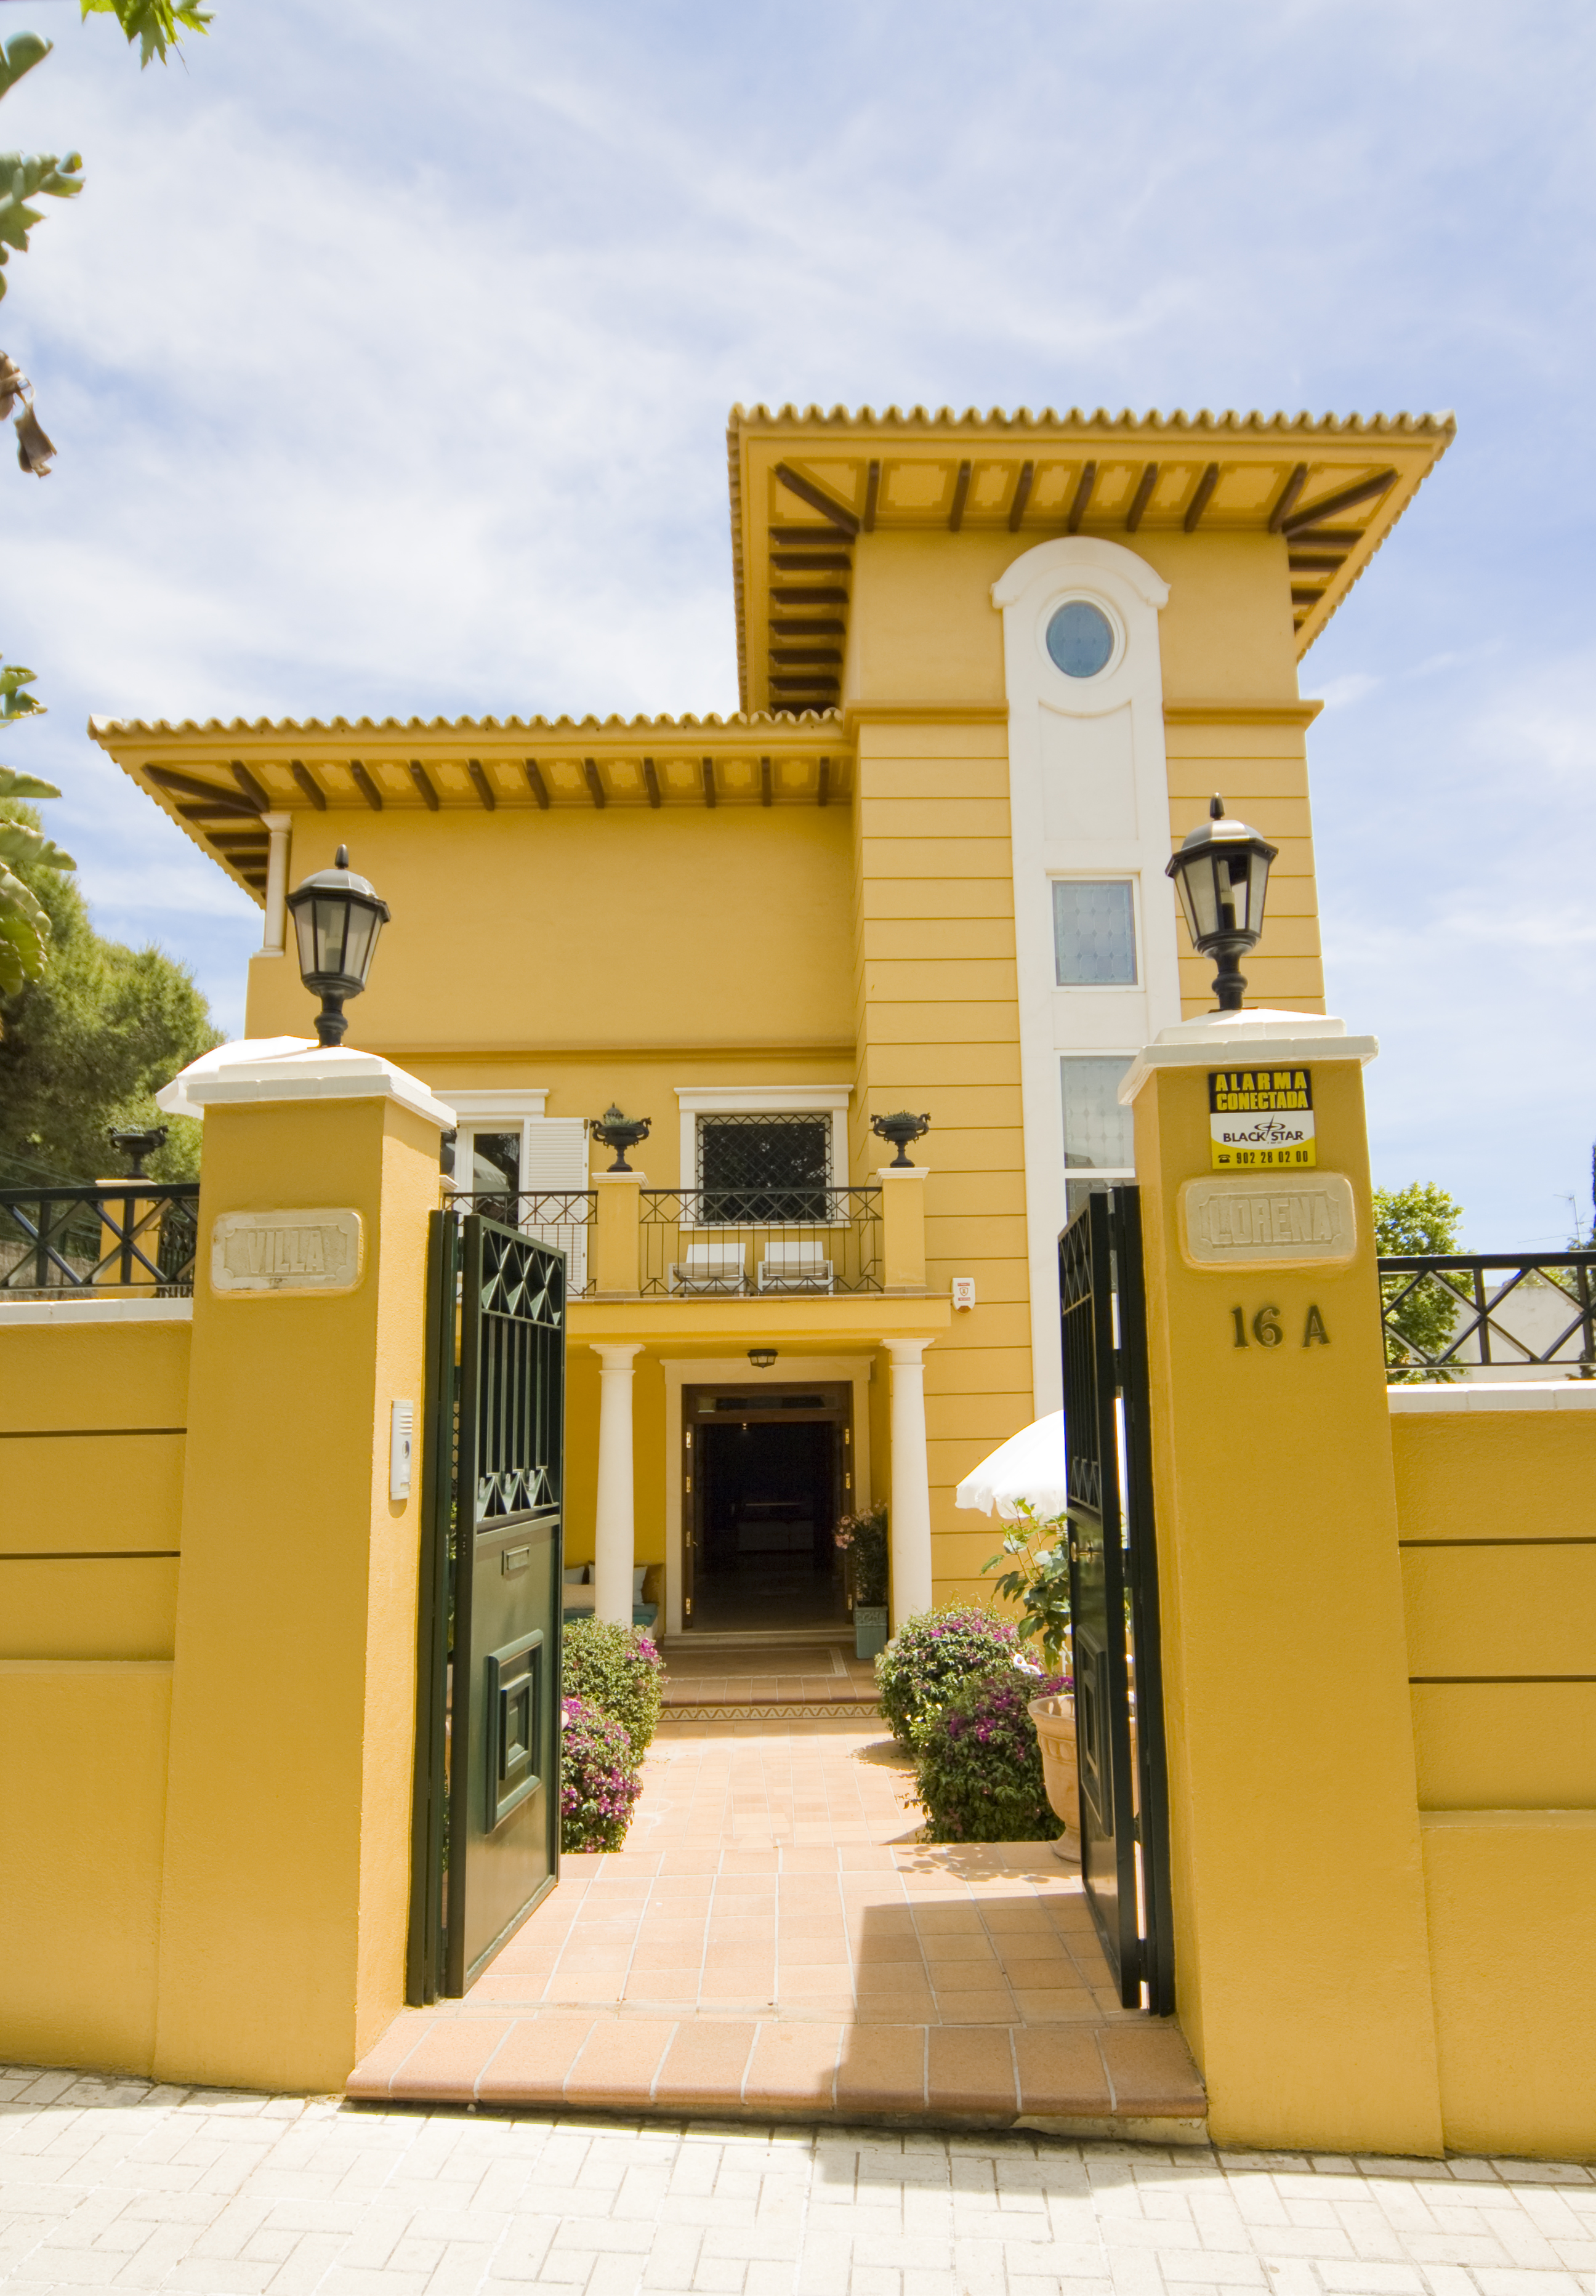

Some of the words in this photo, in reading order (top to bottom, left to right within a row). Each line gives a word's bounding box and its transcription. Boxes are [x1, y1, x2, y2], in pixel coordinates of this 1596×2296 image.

[1215, 1071, 1307, 1091] ALARMA
[1217, 1090, 1308, 1111] CONECTADA
[1223, 1132, 1266, 1143] BLACK
[1271, 1130, 1304, 1141] STAR
[1236, 1152, 1255, 1164] 902
[1261, 1151, 1273, 1163] 28
[1279, 1151, 1291, 1162] 02
[1296, 1150, 1308, 1162] 00
[1209, 1196, 1332, 1244] LORENA
[248, 1230, 325, 1273] VILLA
[1231, 1306, 1283, 1348] 16
[1302, 1304, 1331, 1348] A
